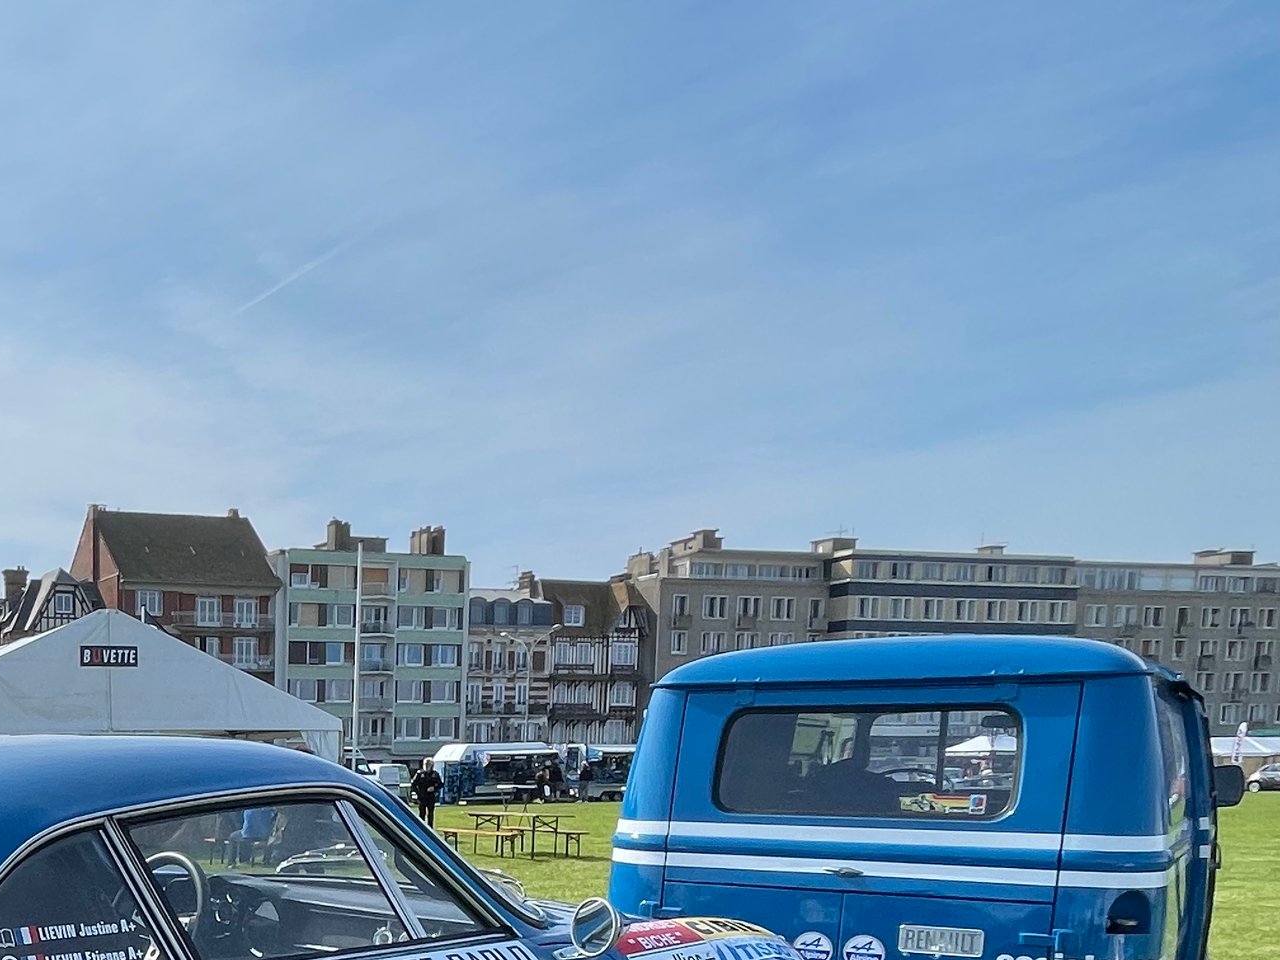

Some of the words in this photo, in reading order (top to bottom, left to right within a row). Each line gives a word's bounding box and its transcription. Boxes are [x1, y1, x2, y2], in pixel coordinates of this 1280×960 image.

[83, 648, 136, 663] BUVETTE
[39, 924, 77, 941] LIEVIN
[79, 921, 119, 938] Justine
[121, 919, 137, 933] A+
[903, 928, 979, 954] RENAULT
[128, 946, 144, 960] A+
